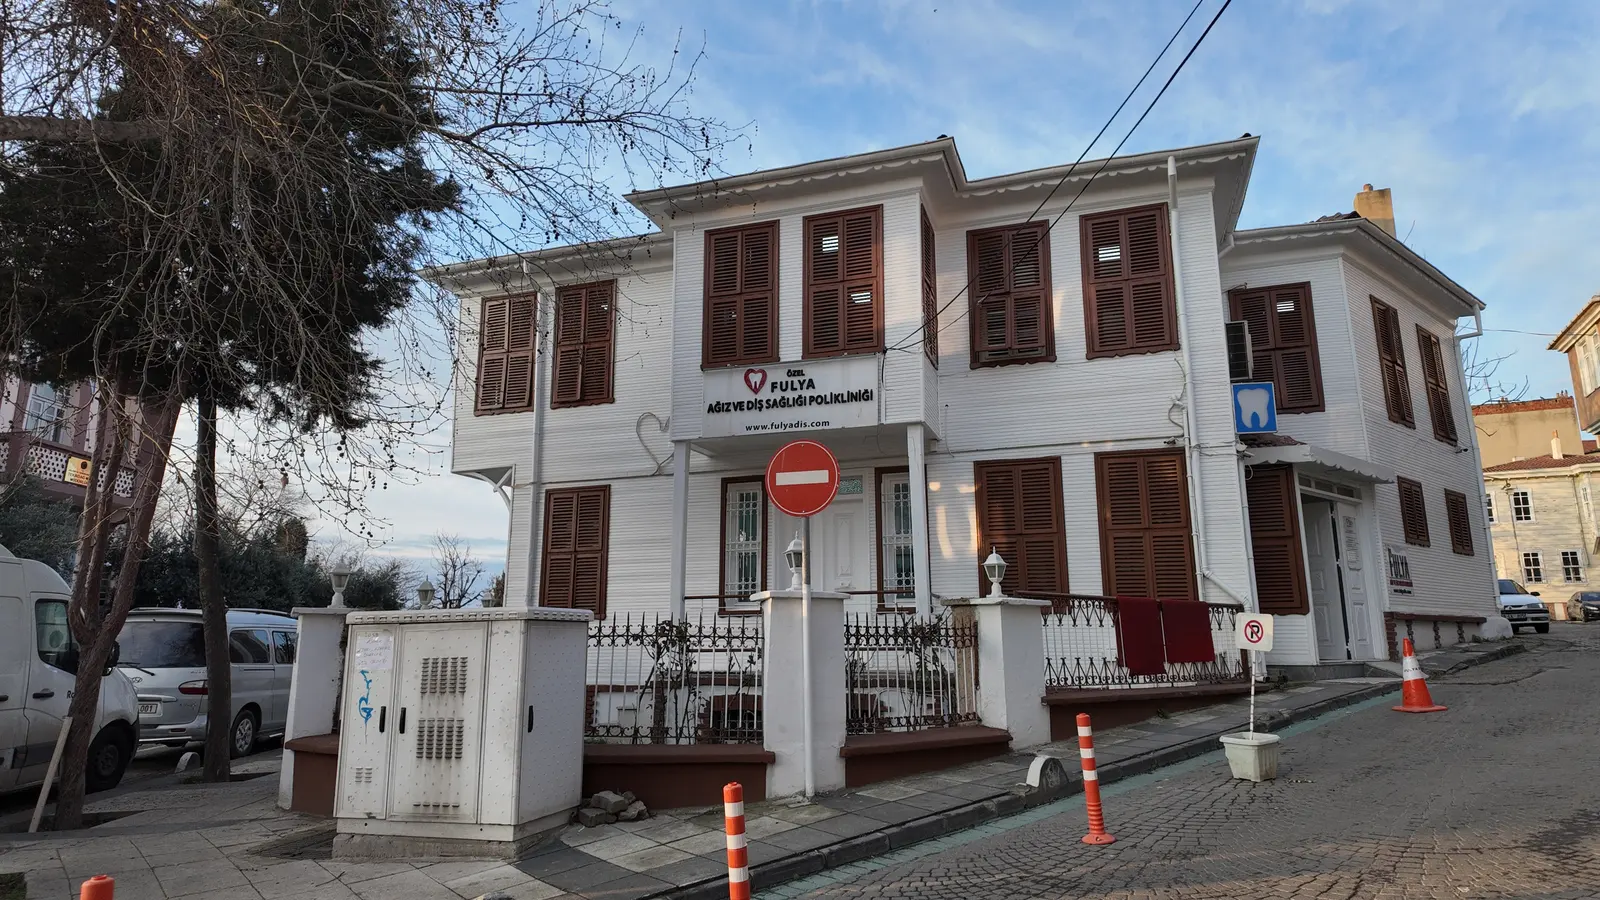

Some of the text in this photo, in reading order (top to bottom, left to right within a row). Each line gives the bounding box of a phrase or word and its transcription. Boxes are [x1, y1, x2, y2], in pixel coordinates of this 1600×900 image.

[786, 368, 805, 378] ÖZEL
[771, 378, 816, 393] FULYA
[707, 388, 873, 414] AĞIZ VE DİŞ SAĞLIĞI POLİKLİNİĞİ
[745, 420, 830, 431] www.fulyadis.com
